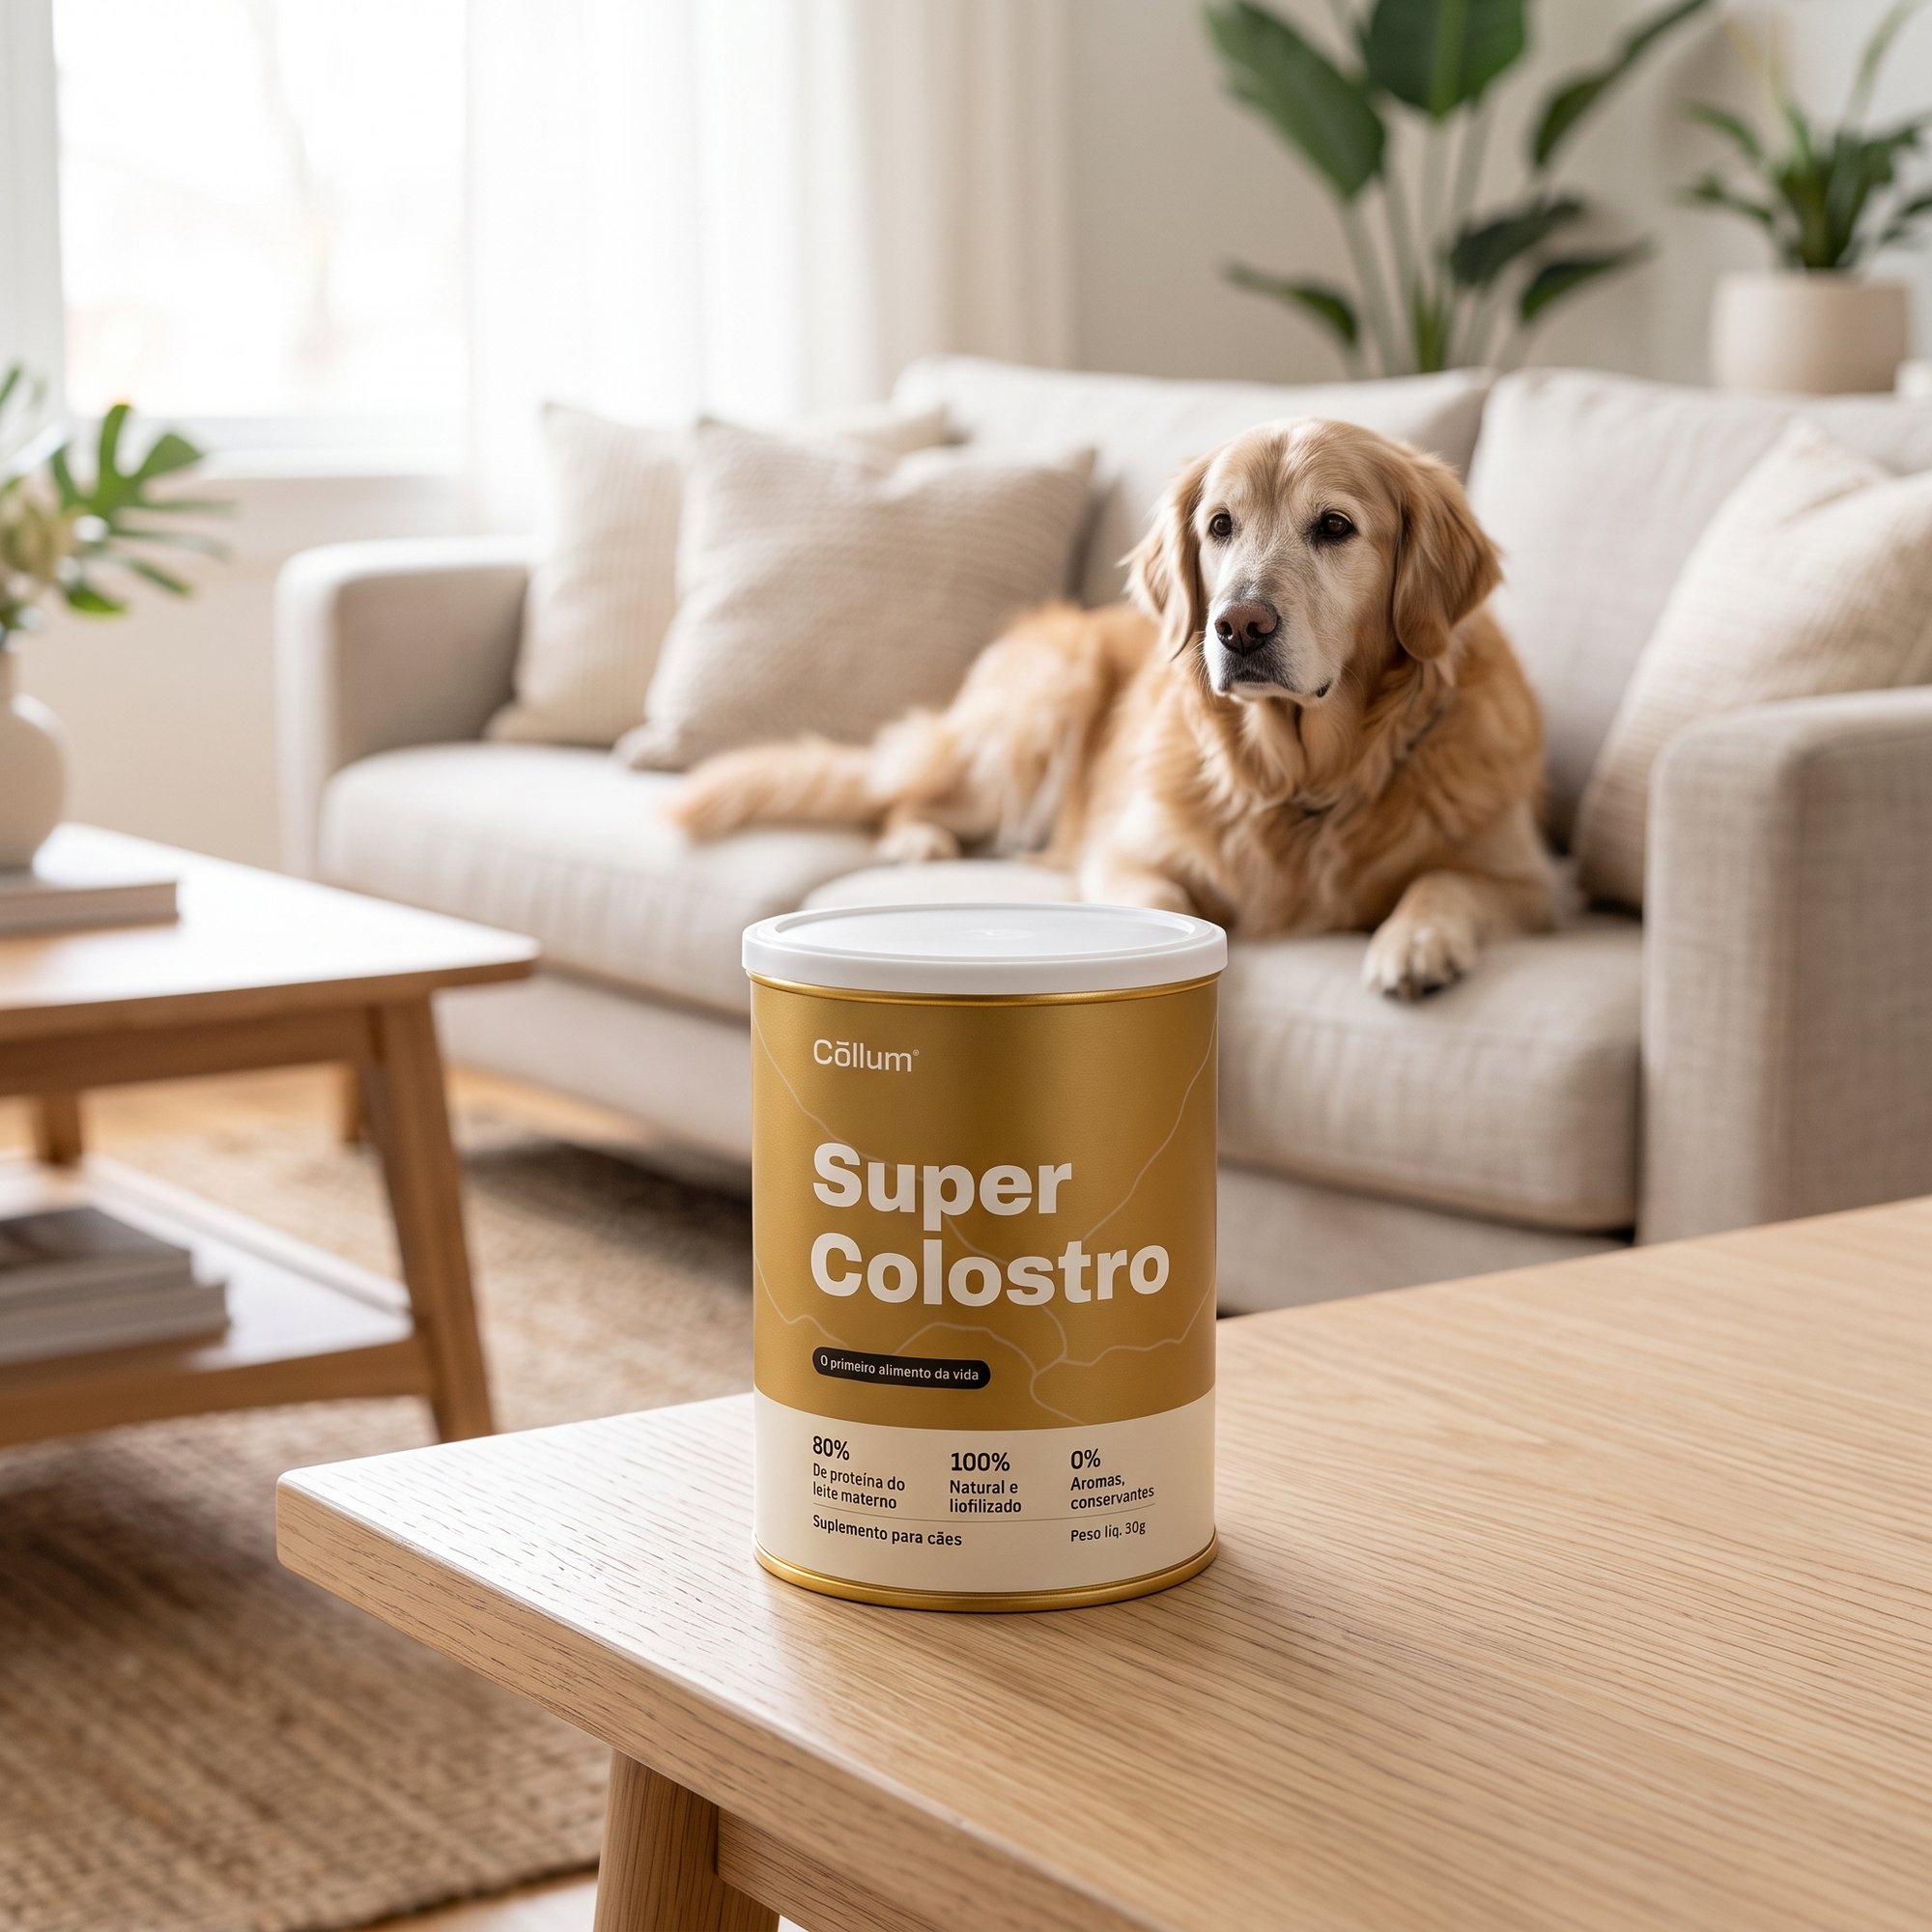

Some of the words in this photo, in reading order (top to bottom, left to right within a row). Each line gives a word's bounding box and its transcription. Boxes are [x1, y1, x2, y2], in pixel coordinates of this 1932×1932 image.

[812, 1142, 1072, 1232] Super
[810, 1232, 1170, 1307] Colostro
[820, 1354, 829, 1367] O
[830, 1357, 876, 1375] primeiro
[878, 1363, 931, 1379] alimento
[934, 1367, 950, 1380] da
[952, 1368, 979, 1380] vida
[812, 1435, 850, 1461] 80%
[1070, 1448, 1101, 1469] 0%
[951, 1452, 1010, 1471] 100%
[812, 1463, 827, 1479] De
[830, 1469, 883, 1490] proteína
[887, 1476, 905, 1492] do
[950, 1480, 1005, 1494] Natural
[1009, 1483, 1018, 1494] e
[1070, 1474, 1125, 1492] Aromas,
[812, 1481, 838, 1500] leite
[840, 1491, 897, 1509] materno
[950, 1498, 1022, 1513] liofilizado
[1070, 1487, 1154, 1510] conservantes
[812, 1514, 888, 1541] Suplemento
[892, 1530, 923, 1545] para
[927, 1531, 962, 1546] cães
[1070, 1528, 1101, 1542] Peso
[1124, 1520, 1146, 1535] 30g
